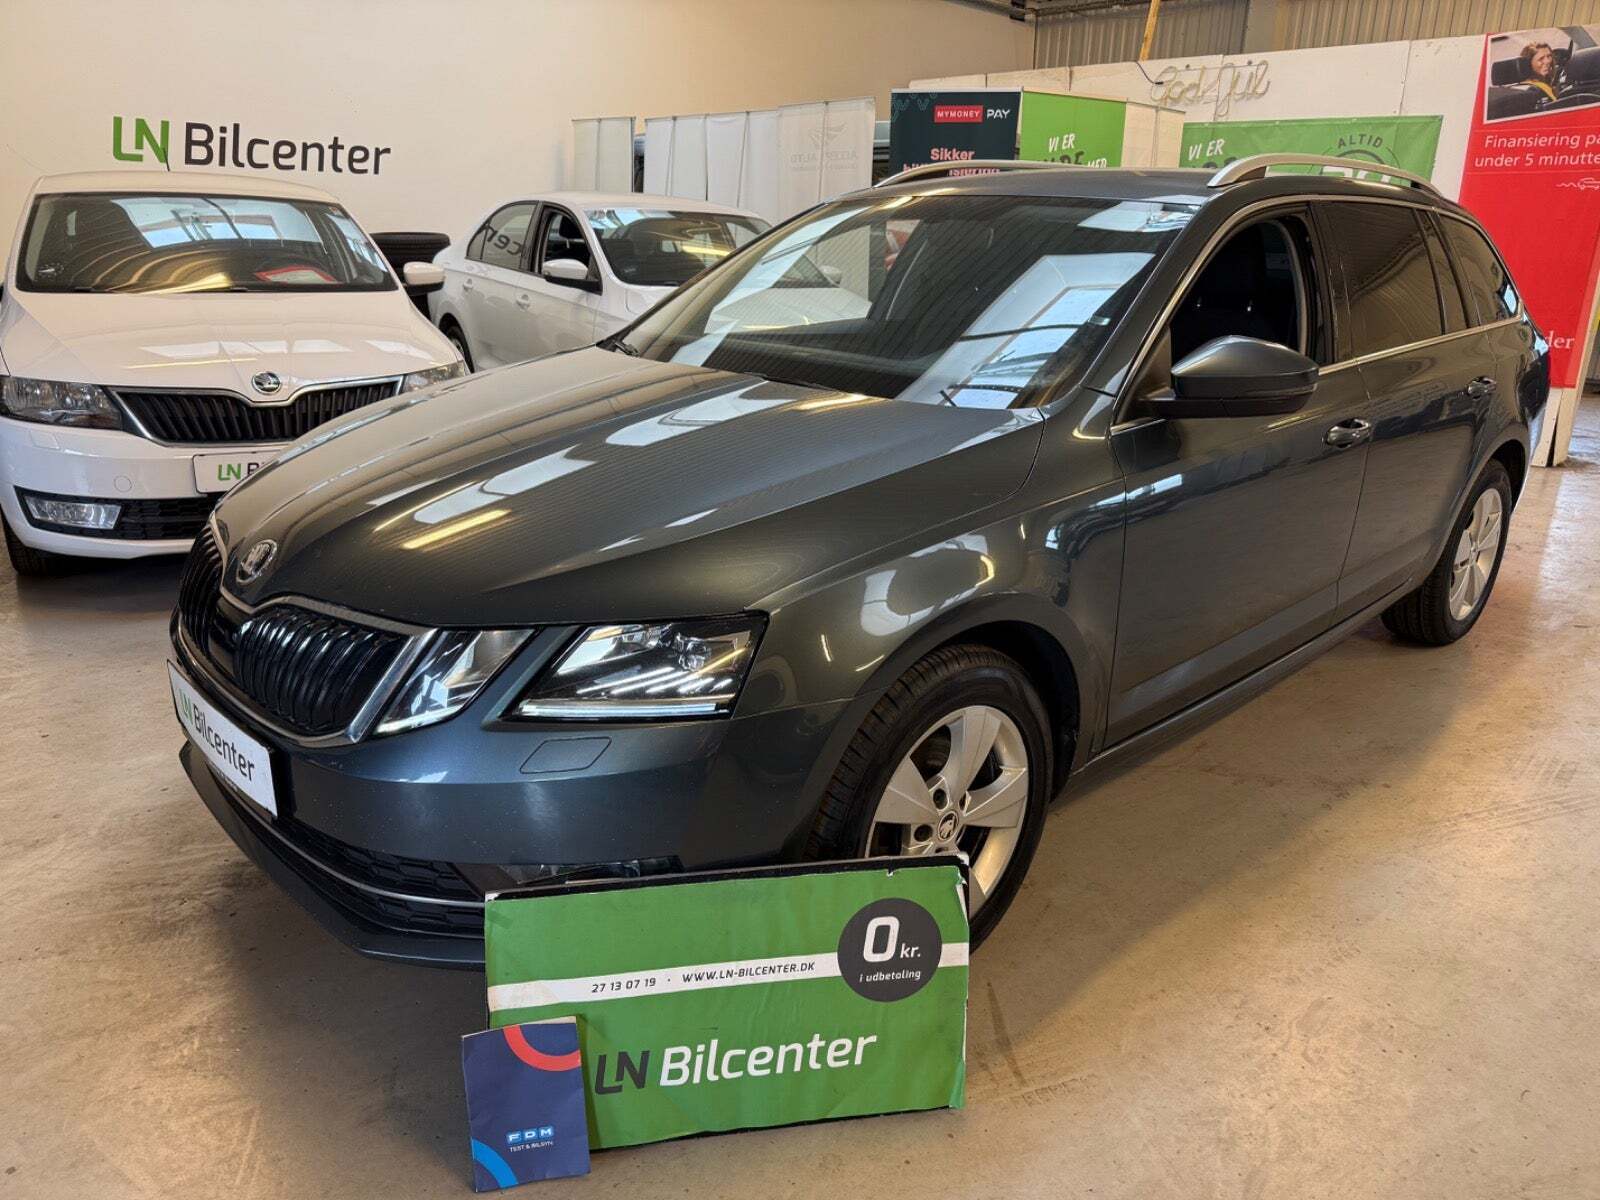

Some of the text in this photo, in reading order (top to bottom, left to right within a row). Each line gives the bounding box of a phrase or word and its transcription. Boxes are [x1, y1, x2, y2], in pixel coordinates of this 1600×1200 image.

[937, 108, 1011, 119] MYMONEY PAY
[113, 116, 391, 175] LN Bilcenter
[1048, 133, 1075, 153] VI ER
[1338, 133, 1383, 149] ALTID
[1484, 132, 1581, 149] Finansiering
[930, 148, 975, 160] Sikker
[1188, 138, 1225, 161] VI ER
[1474, 153, 1521, 167] under
[1525, 153, 1535, 166] 5
[217, 463, 242, 481] LN
[179, 688, 193, 726] LN
[193, 703, 255, 782] Bilcenter
[863, 915, 921, 963] 0 kr.
[591, 961, 816, 994] 27 13 07 19 WWW.LN-BILCENTER.DK
[866, 970, 921, 982] udbetaling
[594, 1033, 877, 1095] LN Bilcenter
[508, 1127, 552, 1142] FDM
[510, 1144, 524, 1152] TEST
